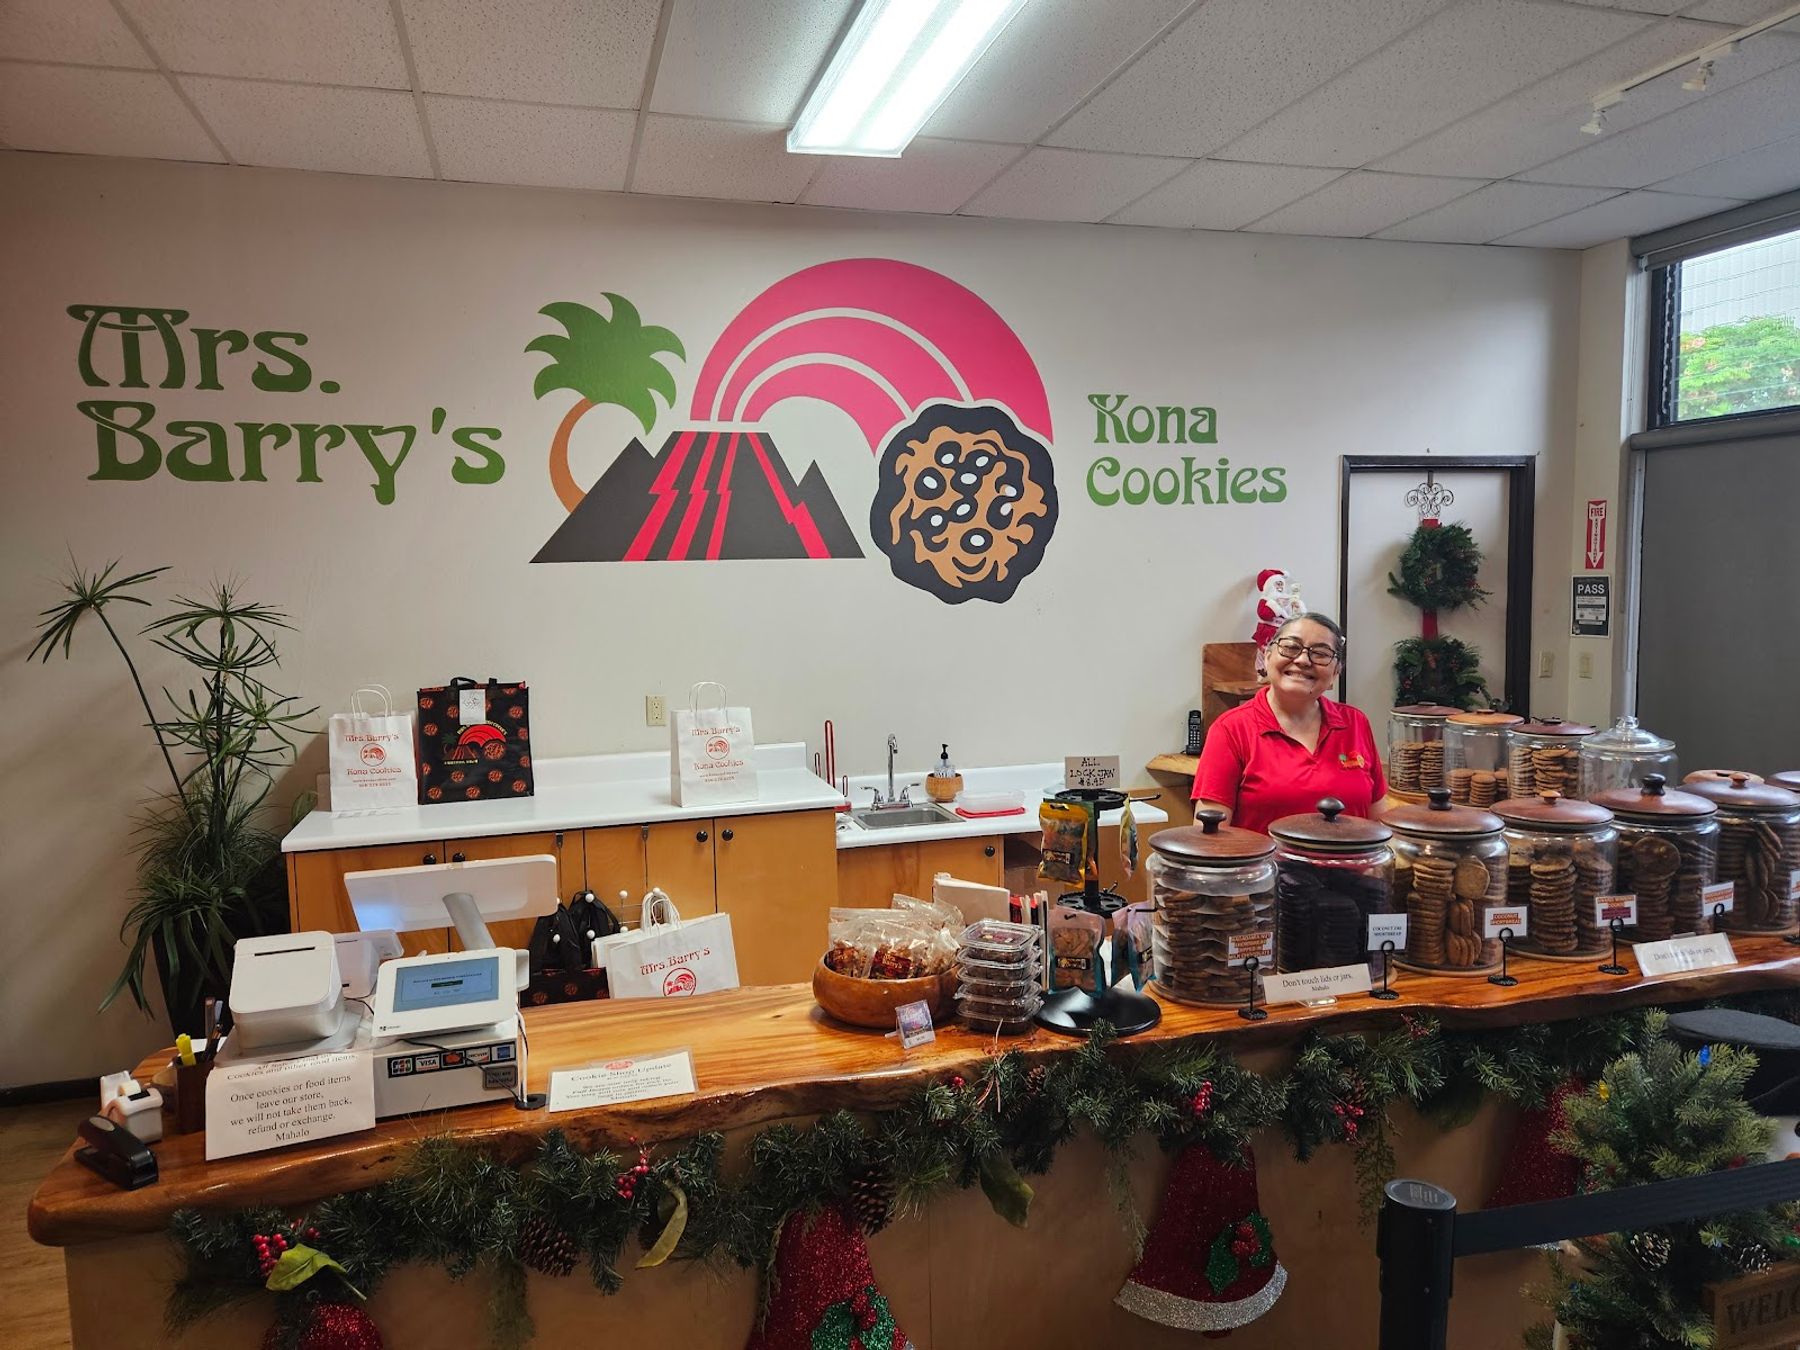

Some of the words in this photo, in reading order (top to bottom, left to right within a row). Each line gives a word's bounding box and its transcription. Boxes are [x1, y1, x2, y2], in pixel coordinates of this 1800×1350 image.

[66, 304, 340, 394] Mrs.
[1087, 394, 1218, 444] Kona
[76, 400, 506, 506] Barry's
[1086, 456, 1287, 507] Cookies
[1591, 507, 1604, 517] FIRE
[1577, 584, 1605, 595] PASS
[346, 768, 368, 776] Kona
[369, 767, 401, 775] Cookies
[694, 762, 714, 770] Kona
[1070, 768, 1095, 778] LOCK
[1282, 978, 1300, 988] Don't
[1301, 975, 1320, 986] touch
[1320, 975, 1332, 983] lids
[227, 1069, 264, 1080] Cookies
[266, 1066, 282, 1074] and
[284, 1063, 307, 1071] other
[571, 1072, 607, 1082] Cookie
[610, 1069, 635, 1078] Shop
[638, 1062, 672, 1074] Update
[230, 1091, 255, 1103] Once
[256, 1085, 290, 1098] cookies
[293, 1084, 302, 1092] or
[305, 1079, 326, 1090] food
[328, 1075, 352, 1084] items
[256, 1100, 279, 1110] leave
[282, 1096, 297, 1104] our
[230, 1118, 244, 1126] we
[246, 1112, 264, 1123] will
[266, 1110, 282, 1120] not
[283, 1106, 302, 1116] take
[304, 1102, 326, 1114] them
[248, 1123, 277, 1136] refund
[279, 1121, 290, 1129] or
[276, 1128, 310, 1142] Mahalo
